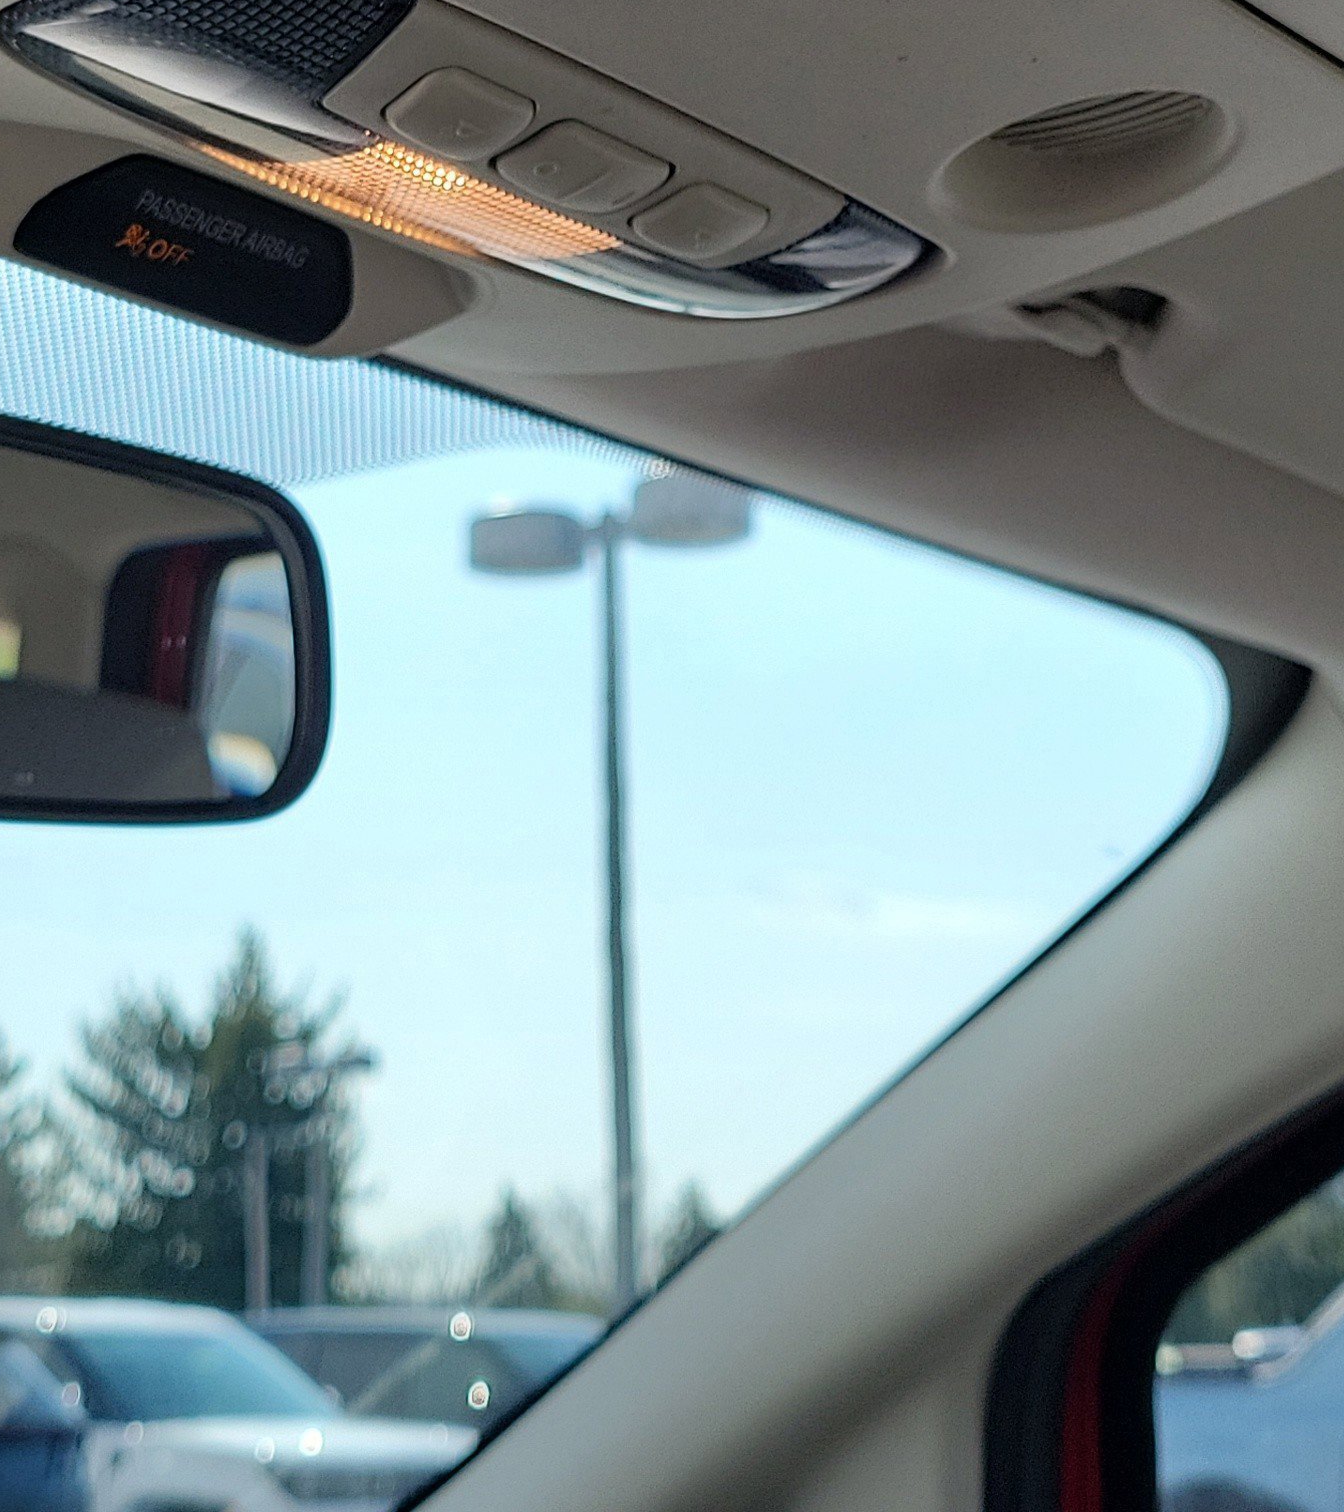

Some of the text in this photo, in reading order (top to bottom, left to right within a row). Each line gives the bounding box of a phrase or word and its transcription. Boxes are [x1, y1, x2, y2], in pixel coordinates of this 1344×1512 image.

[135, 188, 311, 270] PASSENGER AIRBAG
[147, 237, 194, 265] OFF
